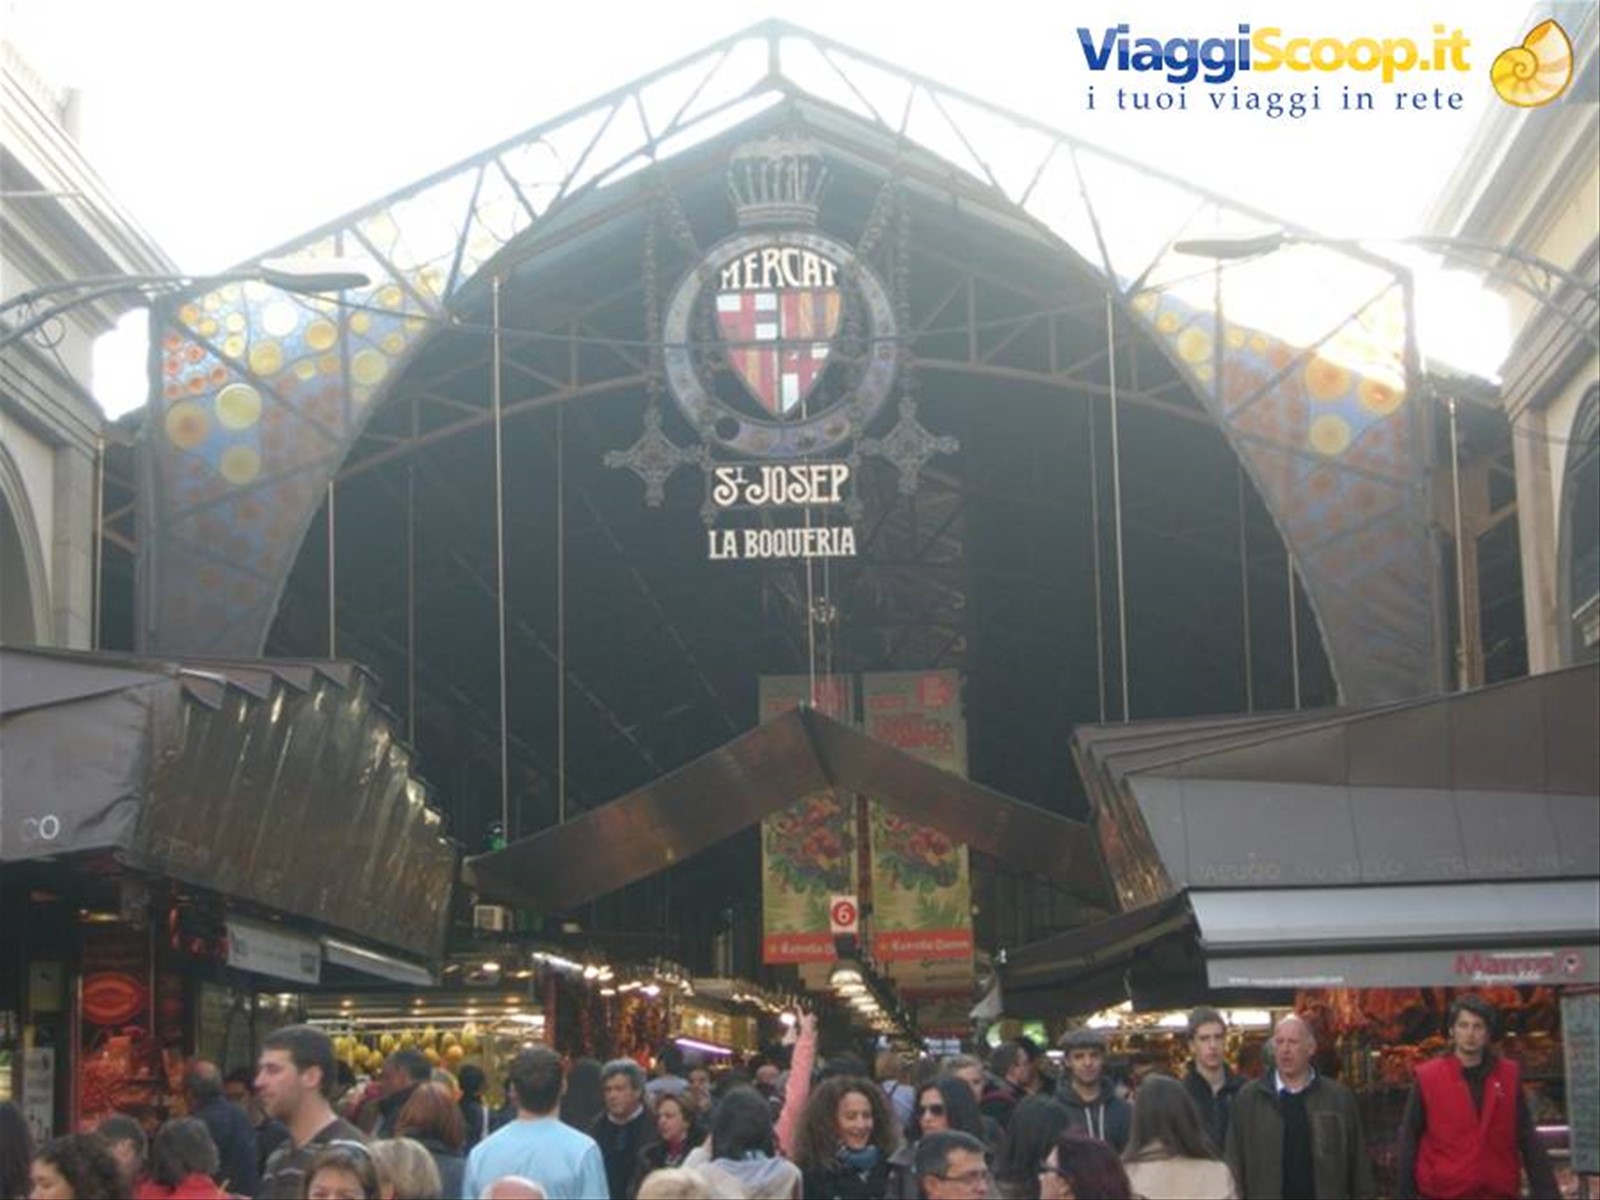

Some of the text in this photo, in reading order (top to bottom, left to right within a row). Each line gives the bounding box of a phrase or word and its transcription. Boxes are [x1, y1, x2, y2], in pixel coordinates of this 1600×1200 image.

[721, 247, 838, 290] MERCAT
[746, 464, 850, 504] JOSEP
[708, 526, 857, 560] LA BOQUERIA
[838, 901, 850, 922] 6
[1452, 950, 1554, 975] Marcos
